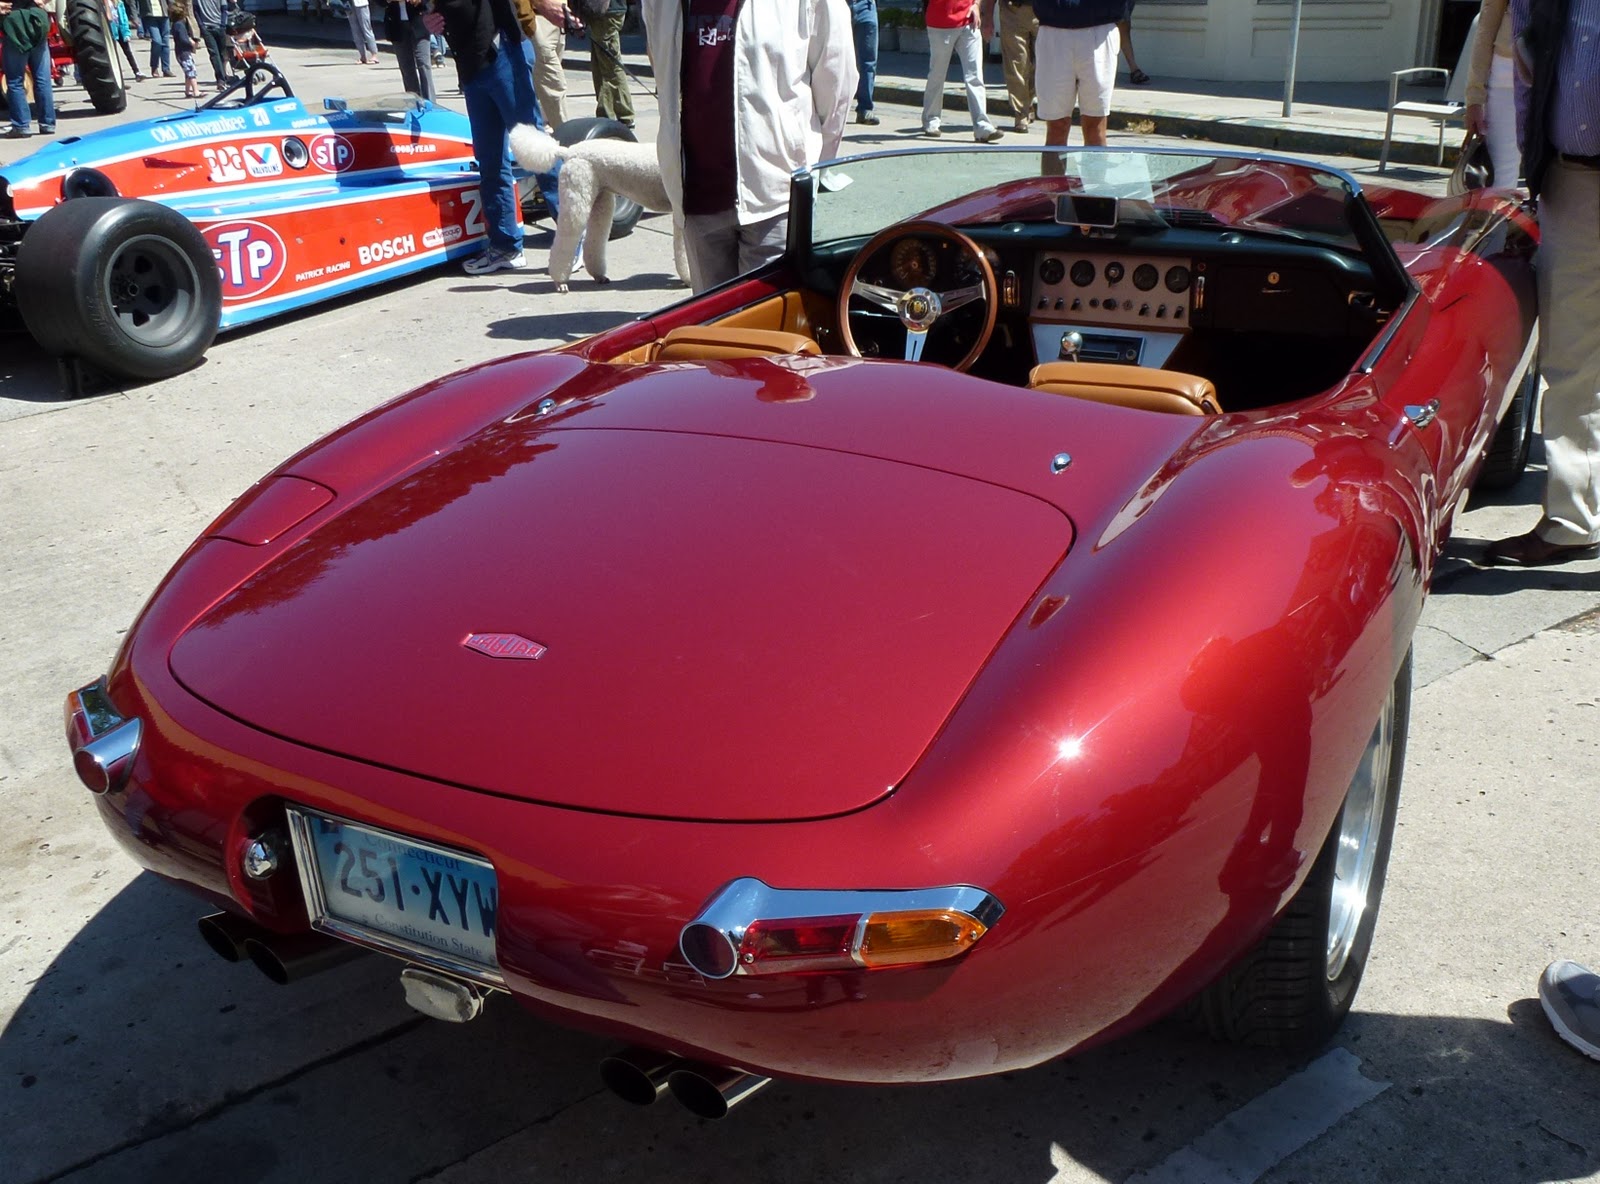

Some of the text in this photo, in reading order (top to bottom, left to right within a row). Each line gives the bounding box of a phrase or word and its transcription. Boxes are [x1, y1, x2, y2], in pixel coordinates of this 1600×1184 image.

[150, 115, 248, 143] Old Milwaukee
[202, 145, 247, 183] PPG
[315, 138, 348, 166] STP
[390, 143, 437, 155] GOODYEAR
[358, 234, 416, 266] BOSCH
[295, 260, 351, 282] PATRICK RACING
[364, 832, 462, 872] Connecticut
[374, 913, 483, 957] Constitution State
